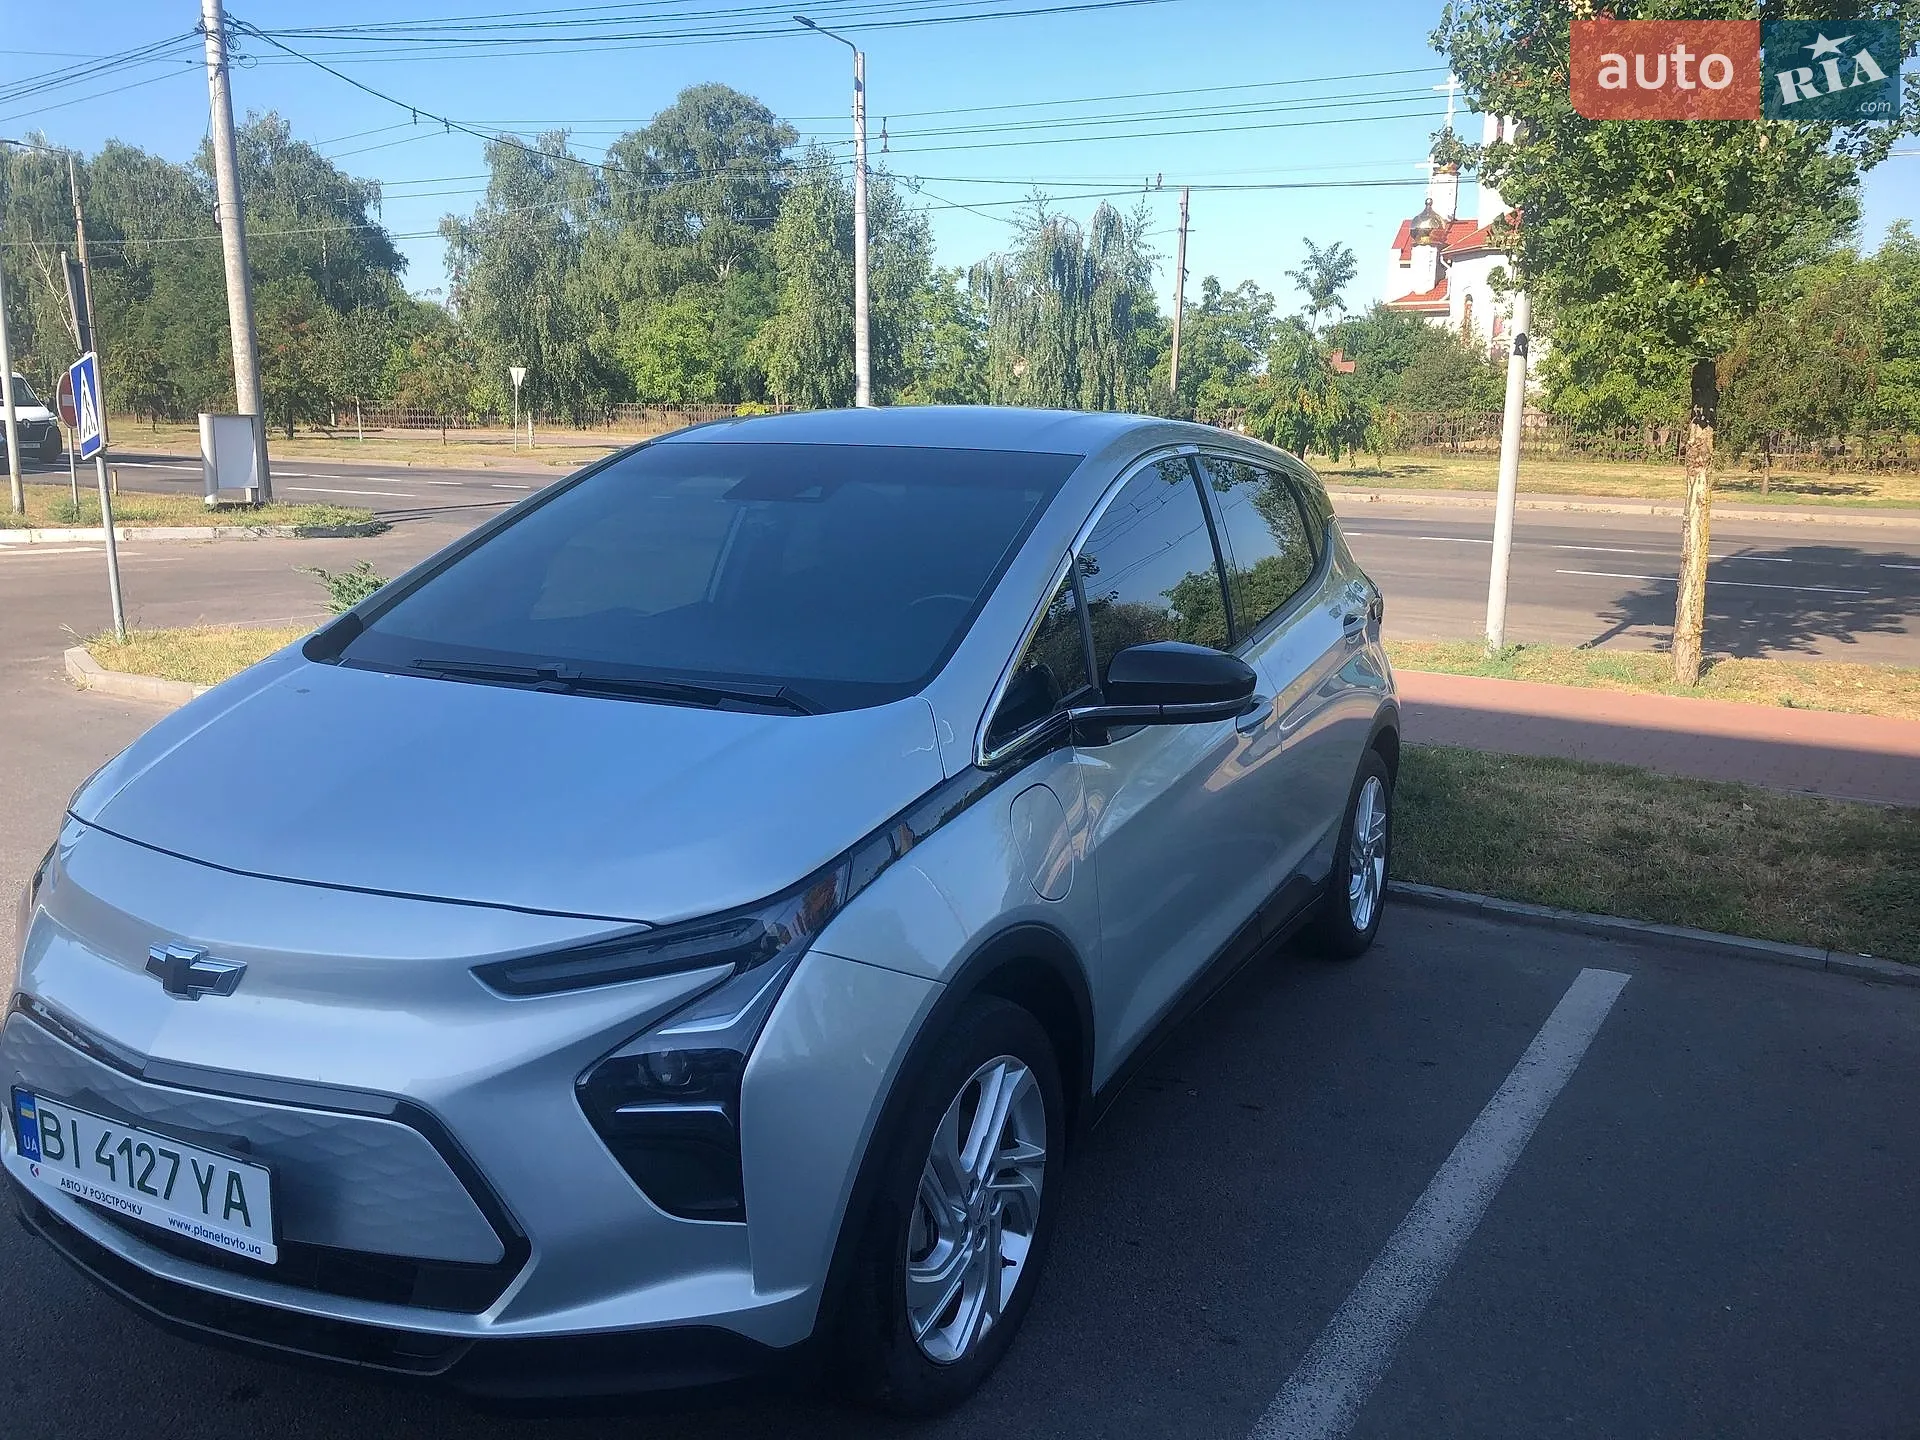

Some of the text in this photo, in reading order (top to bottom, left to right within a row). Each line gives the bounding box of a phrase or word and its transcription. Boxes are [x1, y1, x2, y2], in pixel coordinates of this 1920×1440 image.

[23, 1134, 39, 1154] UA
[38, 1108, 252, 1228] BI 4127 YA
[60, 1178, 143, 1215] АВТО У РОЗСТРОЧКУ
[168, 1217, 262, 1255] www.planetavto.ua
